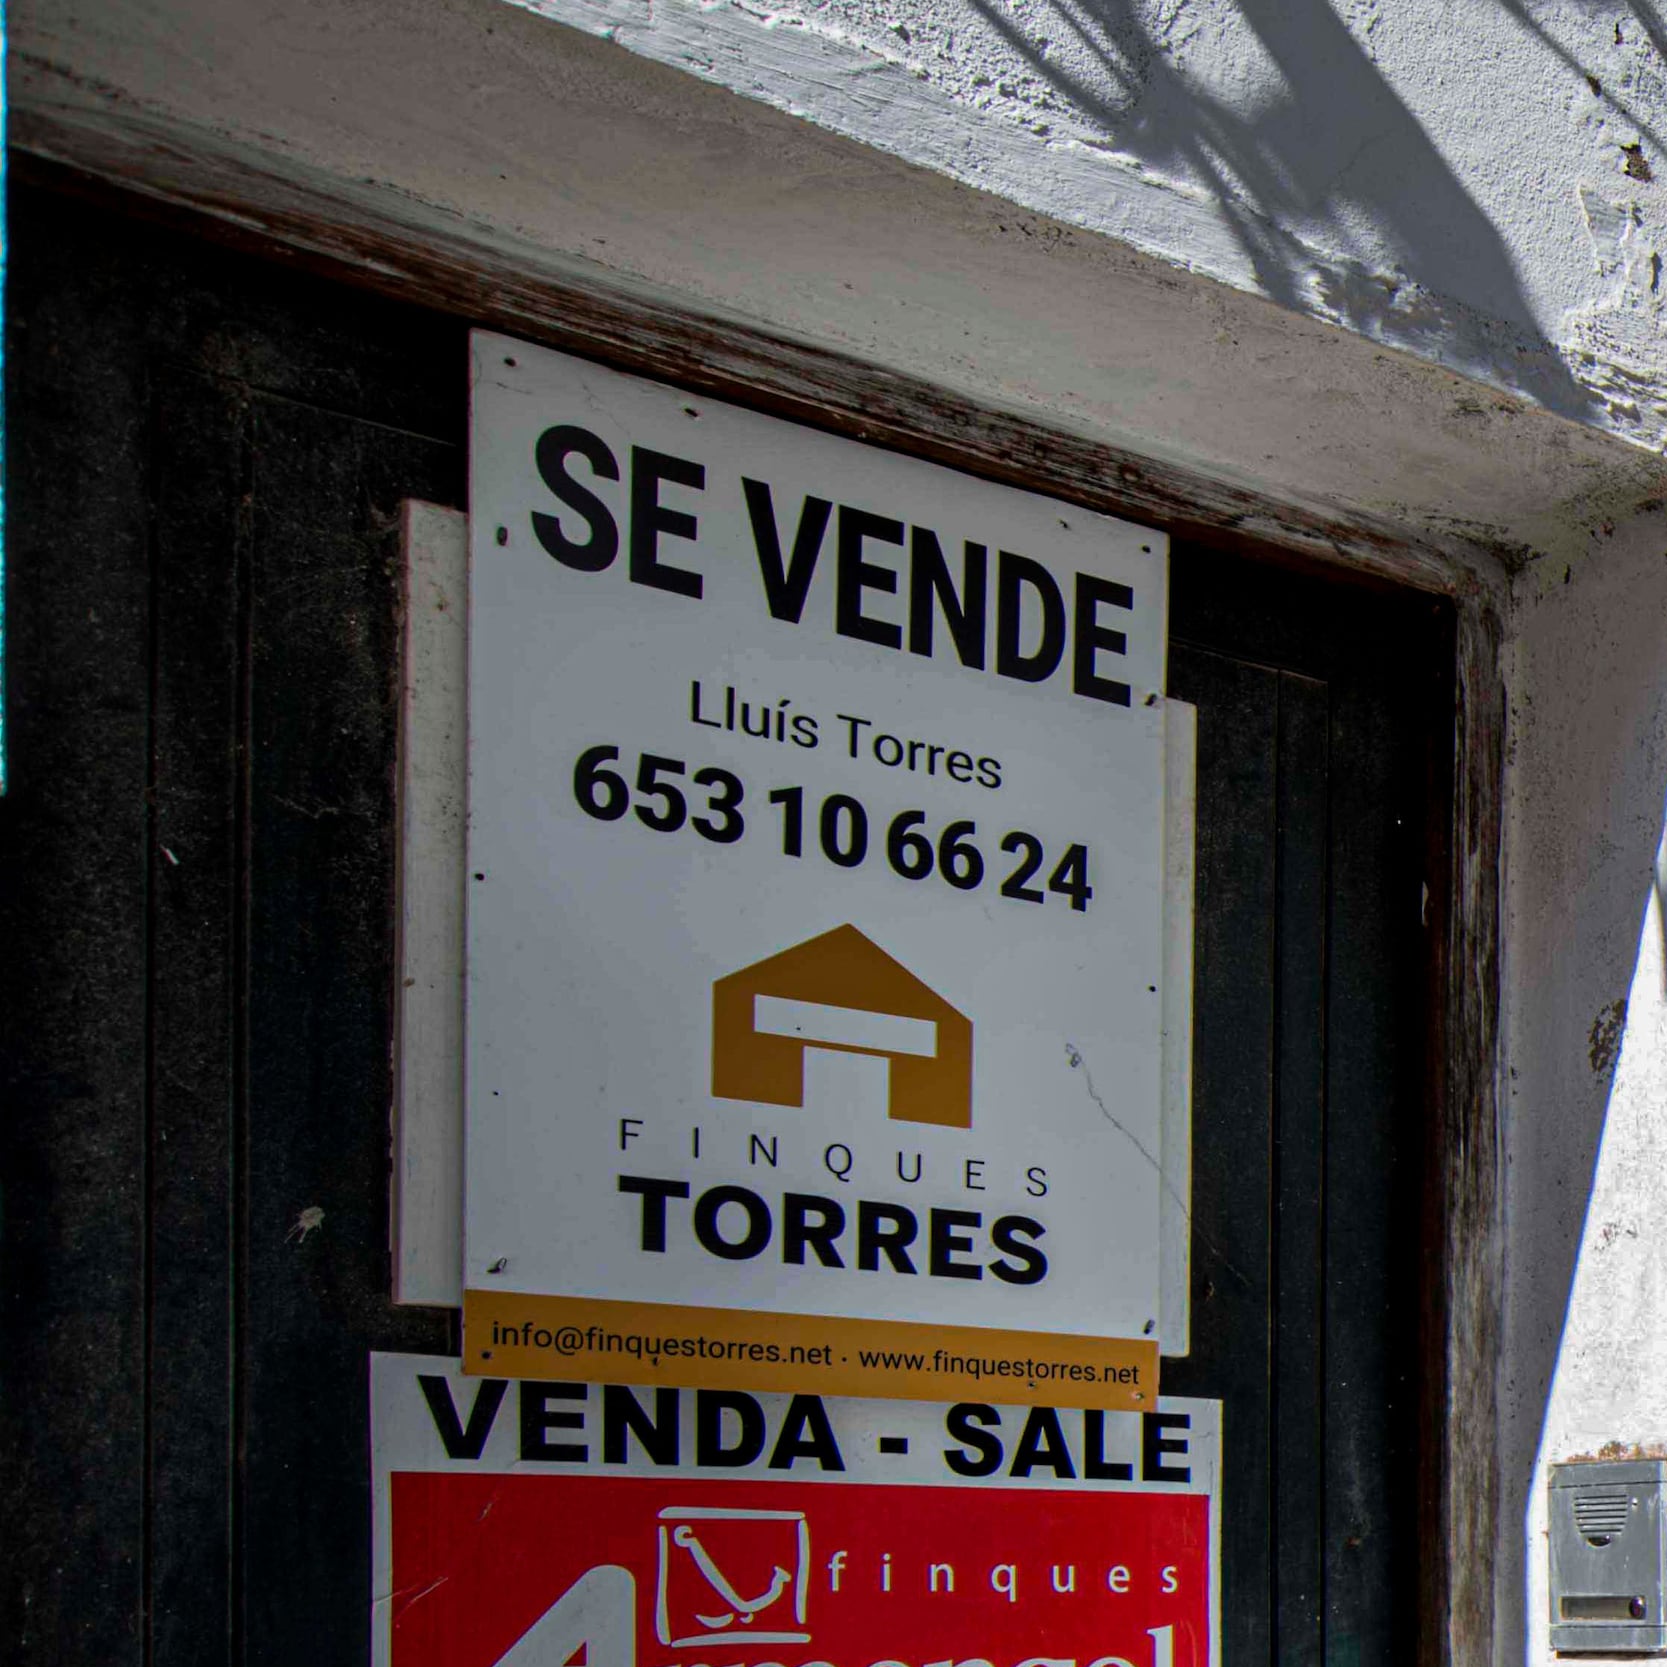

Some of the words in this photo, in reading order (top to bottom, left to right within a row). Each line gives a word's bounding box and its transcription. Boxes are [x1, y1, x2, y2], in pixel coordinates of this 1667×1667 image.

[531, 424, 705, 600] SE
[741, 476, 1134, 707] VENDE
[690, 680, 819, 748] Lluís
[837, 714, 1004, 788] Torres
[573, 744, 745, 844] 653
[770, 785, 869, 868] 10
[887, 809, 984, 891] 66
[1000, 831, 1092, 912] 24
[618, 1118, 1049, 1198] FINQUES
[618, 1175, 1048, 1286] TORRES
[491, 1320, 832, 1367] info@finquestorres.net
[859, 1348, 1140, 1386] www.finquestorres.net
[418, 1373, 844, 1473] VENDA
[943, 1402, 1192, 1482] SALE
[827, 1550, 1180, 1602] finques
